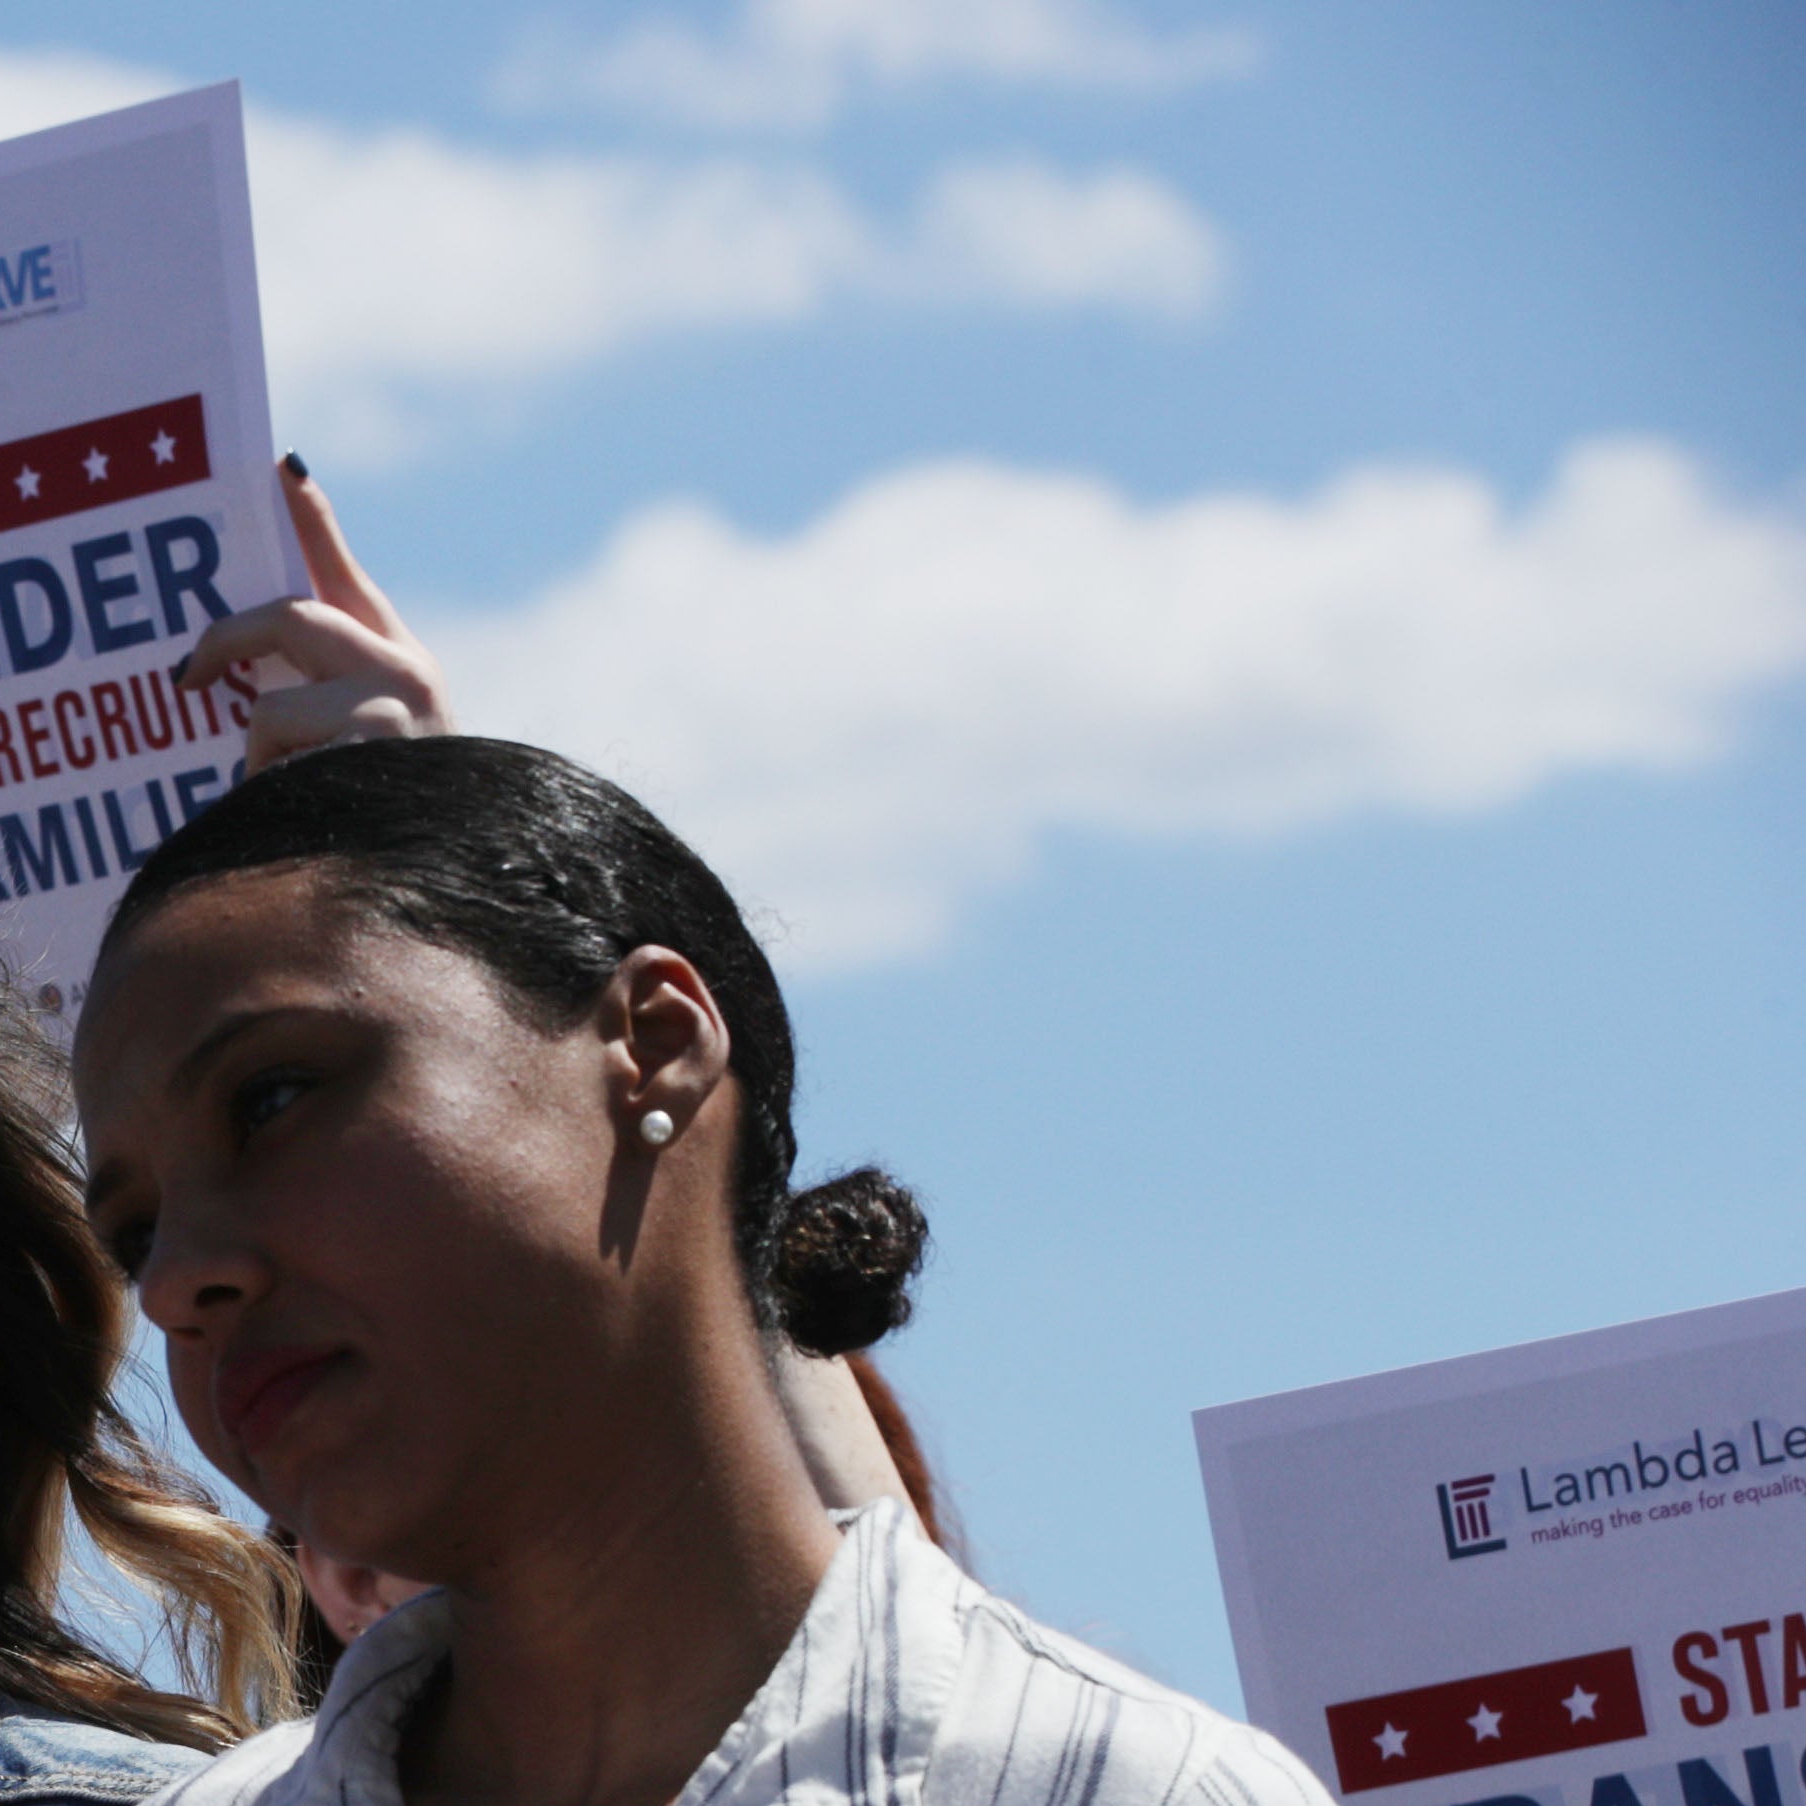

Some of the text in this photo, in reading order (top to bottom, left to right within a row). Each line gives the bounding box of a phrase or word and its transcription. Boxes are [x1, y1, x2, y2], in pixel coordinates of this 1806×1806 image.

[1519, 1427, 1741, 1514] Lambda
[1531, 1517, 1604, 1544] making
[1609, 1507, 1642, 1529] the
[1647, 1499, 1693, 1521] case
[1698, 1489, 1727, 1512] for
